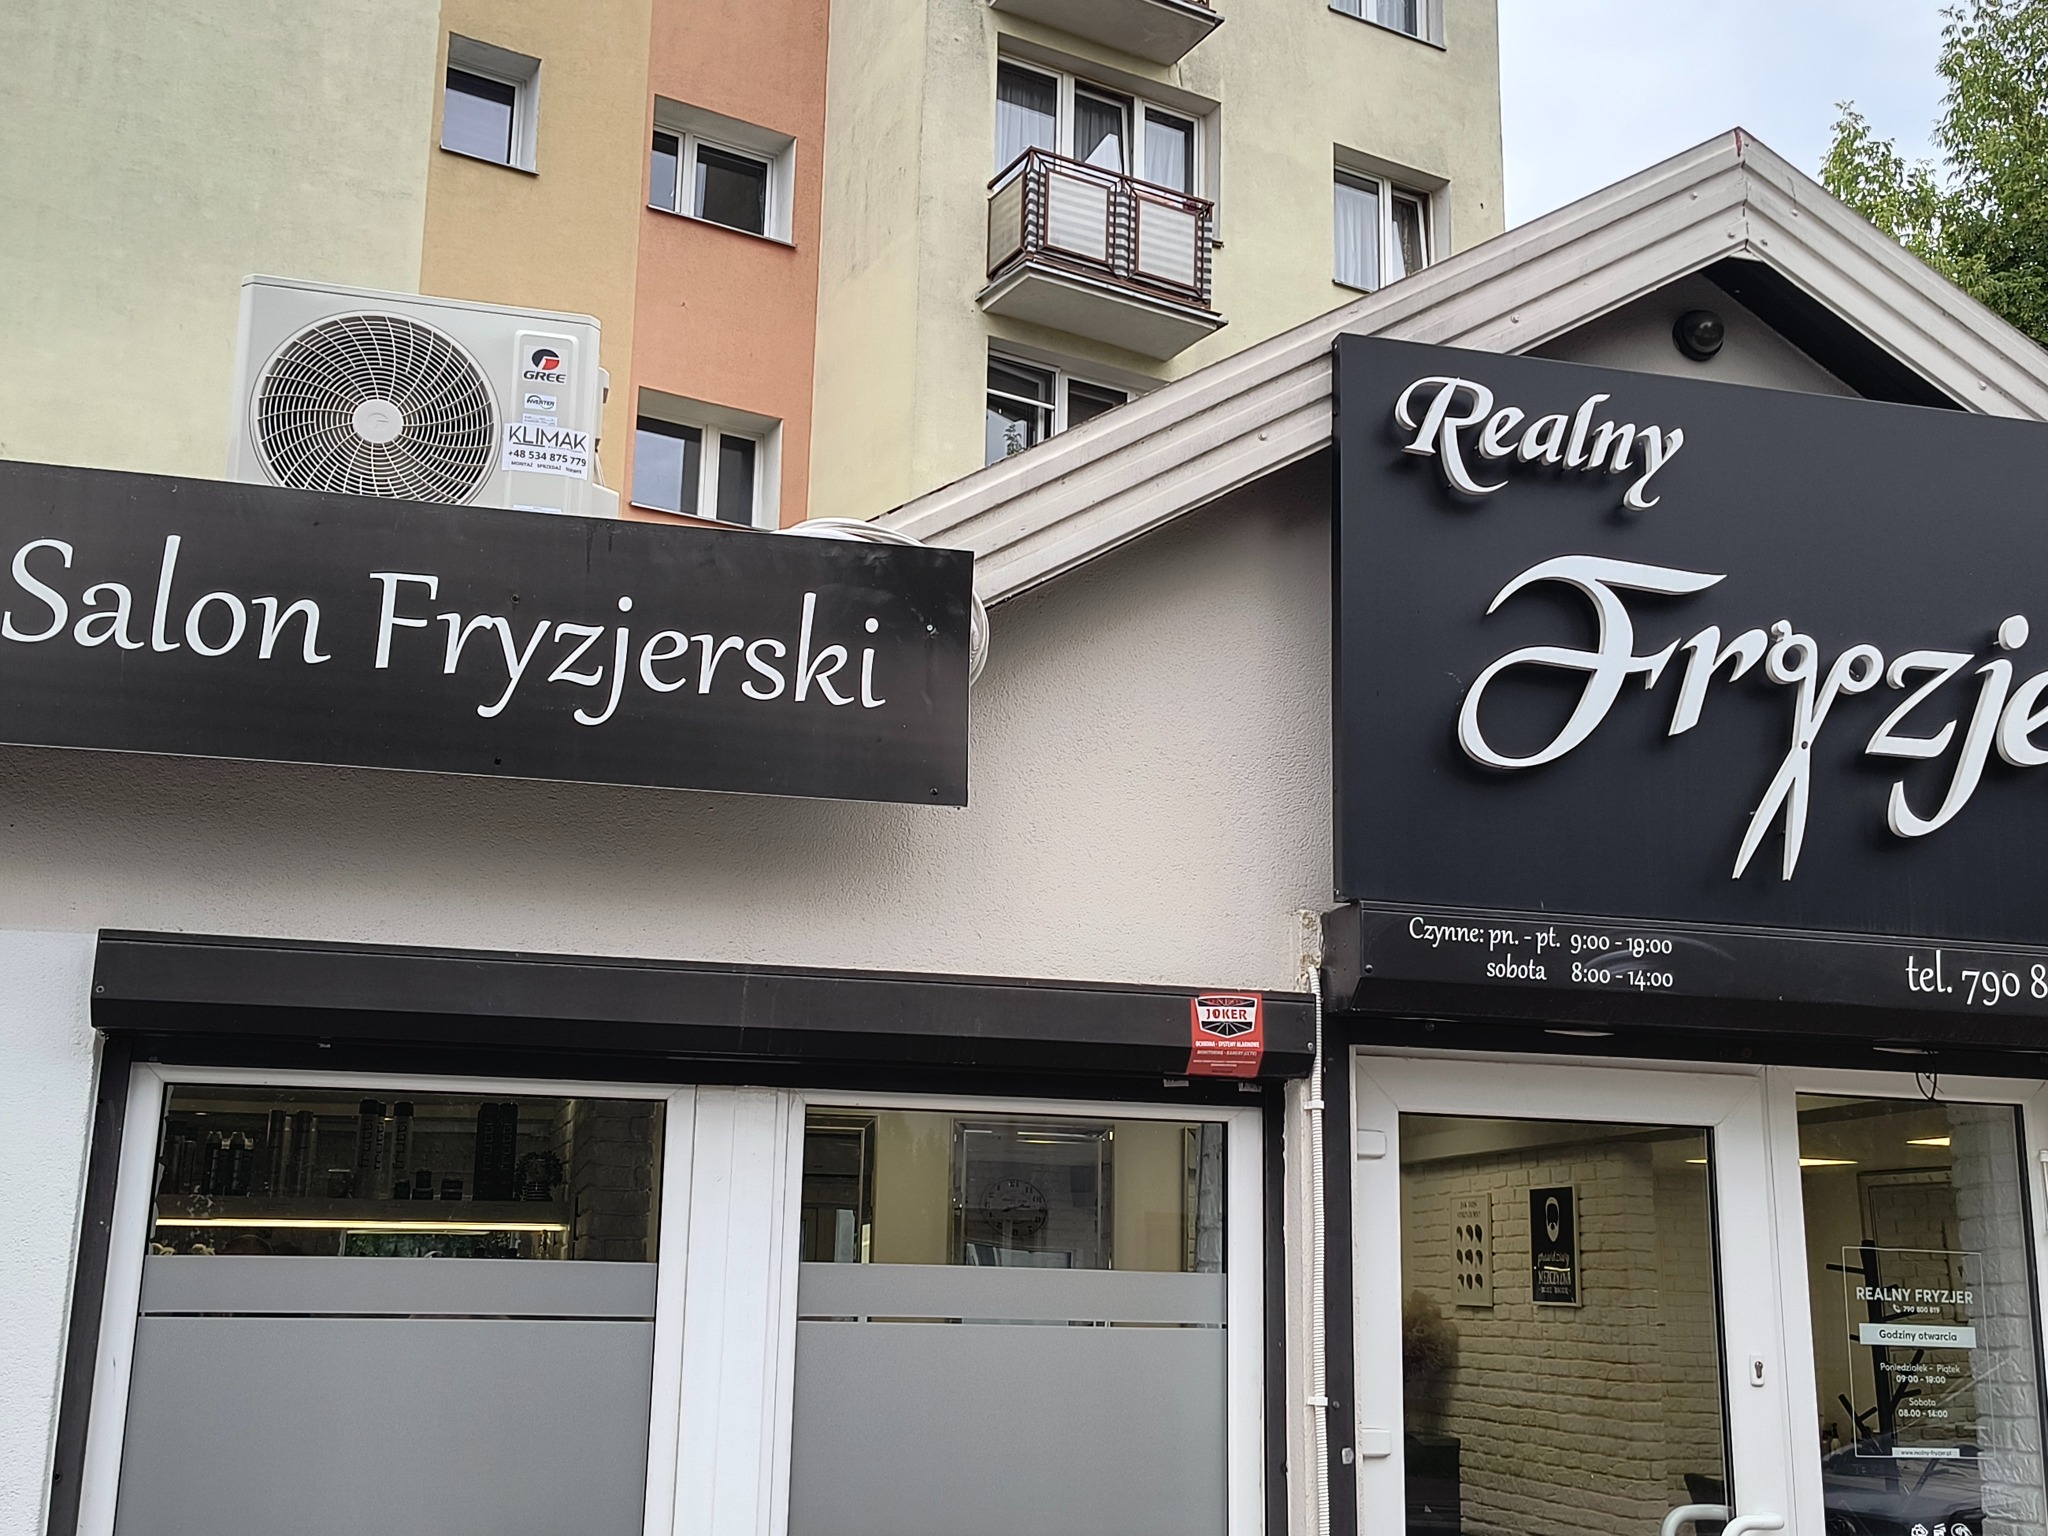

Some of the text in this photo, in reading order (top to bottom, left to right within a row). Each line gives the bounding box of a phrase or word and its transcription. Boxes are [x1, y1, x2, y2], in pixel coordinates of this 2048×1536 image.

[523, 370, 567, 384] GREE
[509, 425, 587, 452] KLIMAK
[1394, 376, 1684, 511] Realny
[508, 449, 587, 467] +48 534 875 779
[1, 535, 887, 726] Salon Fryzjerski
[1408, 917, 1484, 948] Czynne:
[1488, 927, 1519, 951] pn.
[1535, 926, 1561, 953] pt.
[1570, 933, 1610, 953] 9:00
[1627, 936, 1672, 958] 19:00
[1486, 953, 1547, 980] sobota
[1571, 962, 1611, 983] 8:00
[1627, 970, 1674, 991] 14:00
[1905, 949, 1953, 994] tel.
[1961, 970, 2021, 1006] 790
[1206, 1009, 1247, 1020] JOKER
[1855, 1286, 1974, 1305] REALNY FRYZJER
[1902, 1305, 1915, 1313] 790
[1916, 1305, 1929, 1313] 800
[1879, 1329, 1958, 1342] Godziny otwarcia
[1880, 1362, 1928, 1372] Poniedziałek
[1936, 1364, 1961, 1375] Piątek
[1908, 1397, 1936, 1406] Sobota
[1927, 1409, 1948, 1418] 14:00
